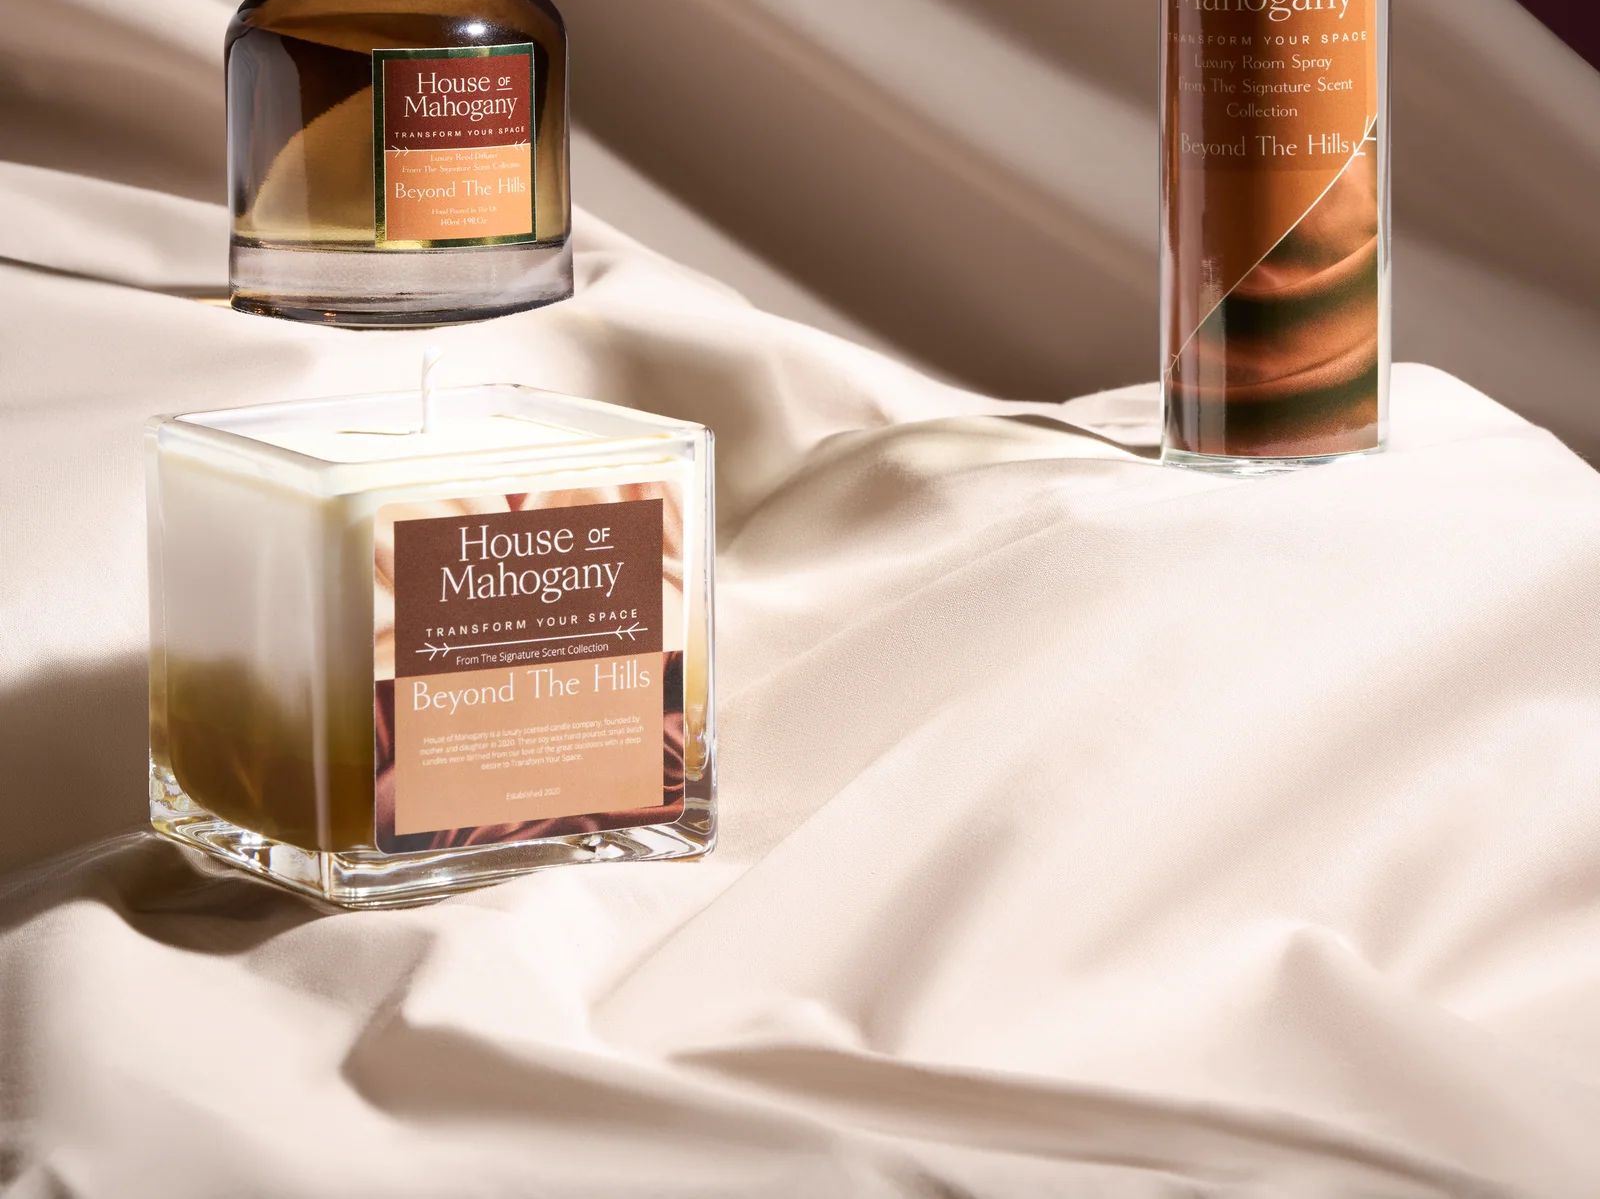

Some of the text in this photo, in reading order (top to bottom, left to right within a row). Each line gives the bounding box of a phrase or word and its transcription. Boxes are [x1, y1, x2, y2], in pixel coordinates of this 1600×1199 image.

[1168, 30, 1367, 46] TRANSFORM YOUR SPACE
[1194, 53, 1333, 73] Luxury Room Spray
[416, 72, 512, 94] House OF
[1178, 76, 1353, 96] From The Signature Scent
[403, 95, 518, 122] Mahogany
[1226, 102, 1298, 118] Collection
[394, 126, 525, 139] TRANSFORM YOUR SPACE
[1181, 132, 1349, 160] Beyond The Hills
[395, 177, 526, 202] Beyond The Hills
[458, 525, 612, 562] House OF
[439, 561, 624, 604] Mahogany
[426, 608, 638, 638] TRANSFORM YOUR SPACE
[456, 642, 609, 666] From The Signature Scent Collection
[413, 659, 650, 715] Beyond The Hills
[544, 786, 561, 796] 2020
